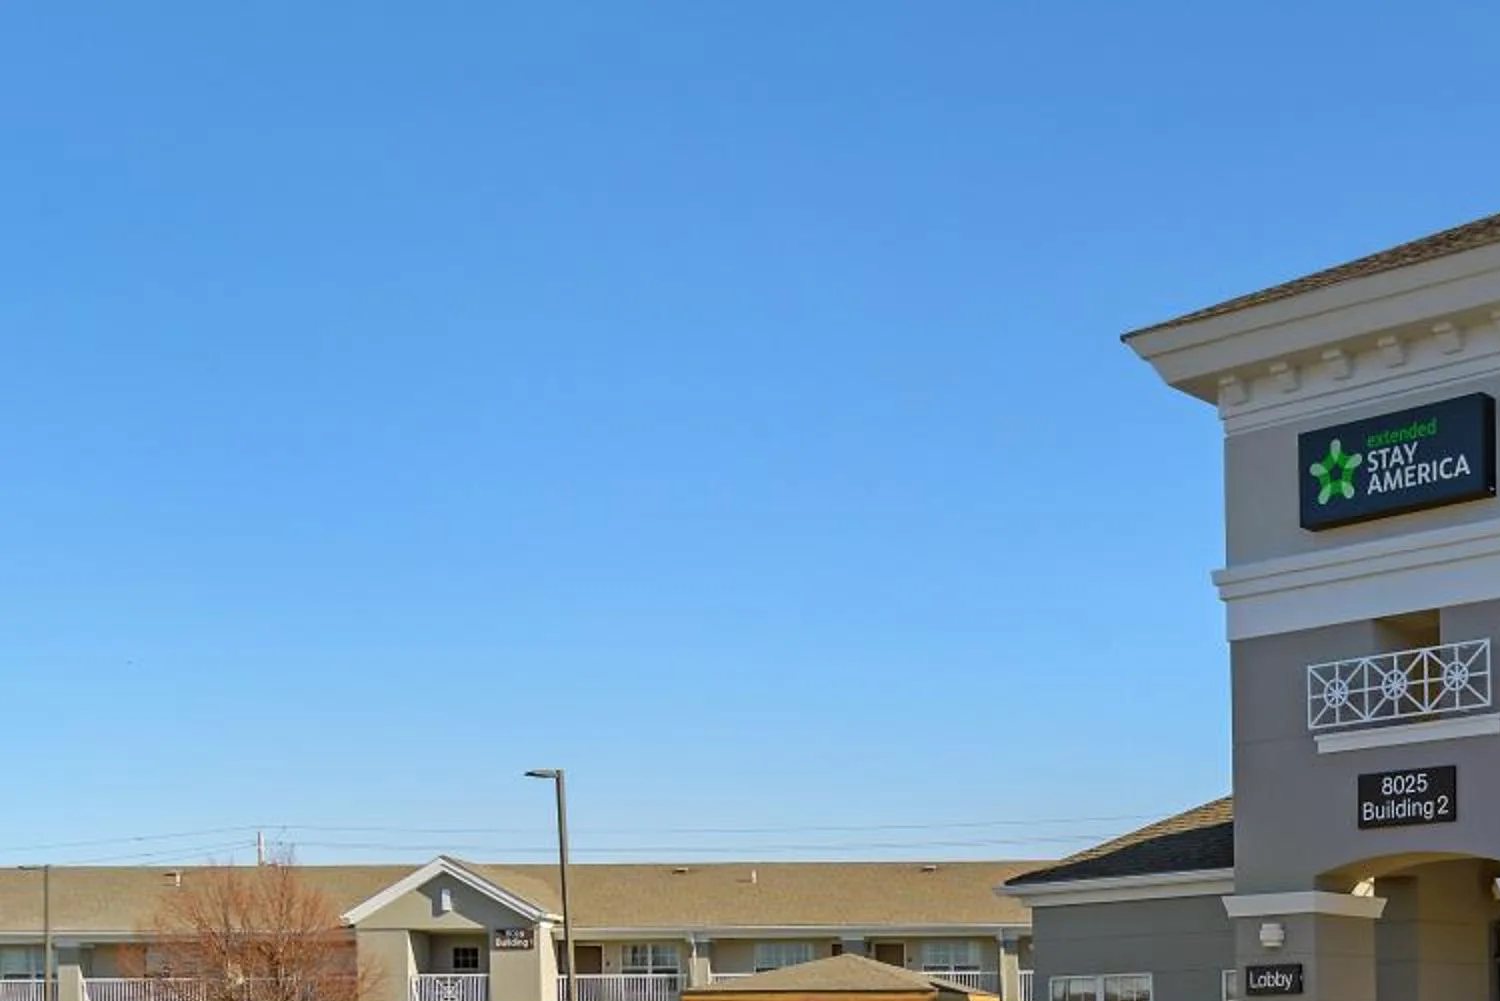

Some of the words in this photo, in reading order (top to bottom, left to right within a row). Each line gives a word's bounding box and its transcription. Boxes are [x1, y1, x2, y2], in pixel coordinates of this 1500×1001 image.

[1367, 418, 1437, 447] extended
[1367, 441, 1418, 473] STAY
[1367, 453, 1471, 495] AMERICA
[1381, 773, 1428, 795] 8025
[1363, 797, 1434, 820] Building
[1437, 795, 1449, 815] 2
[1250, 970, 1293, 991] Lobby
